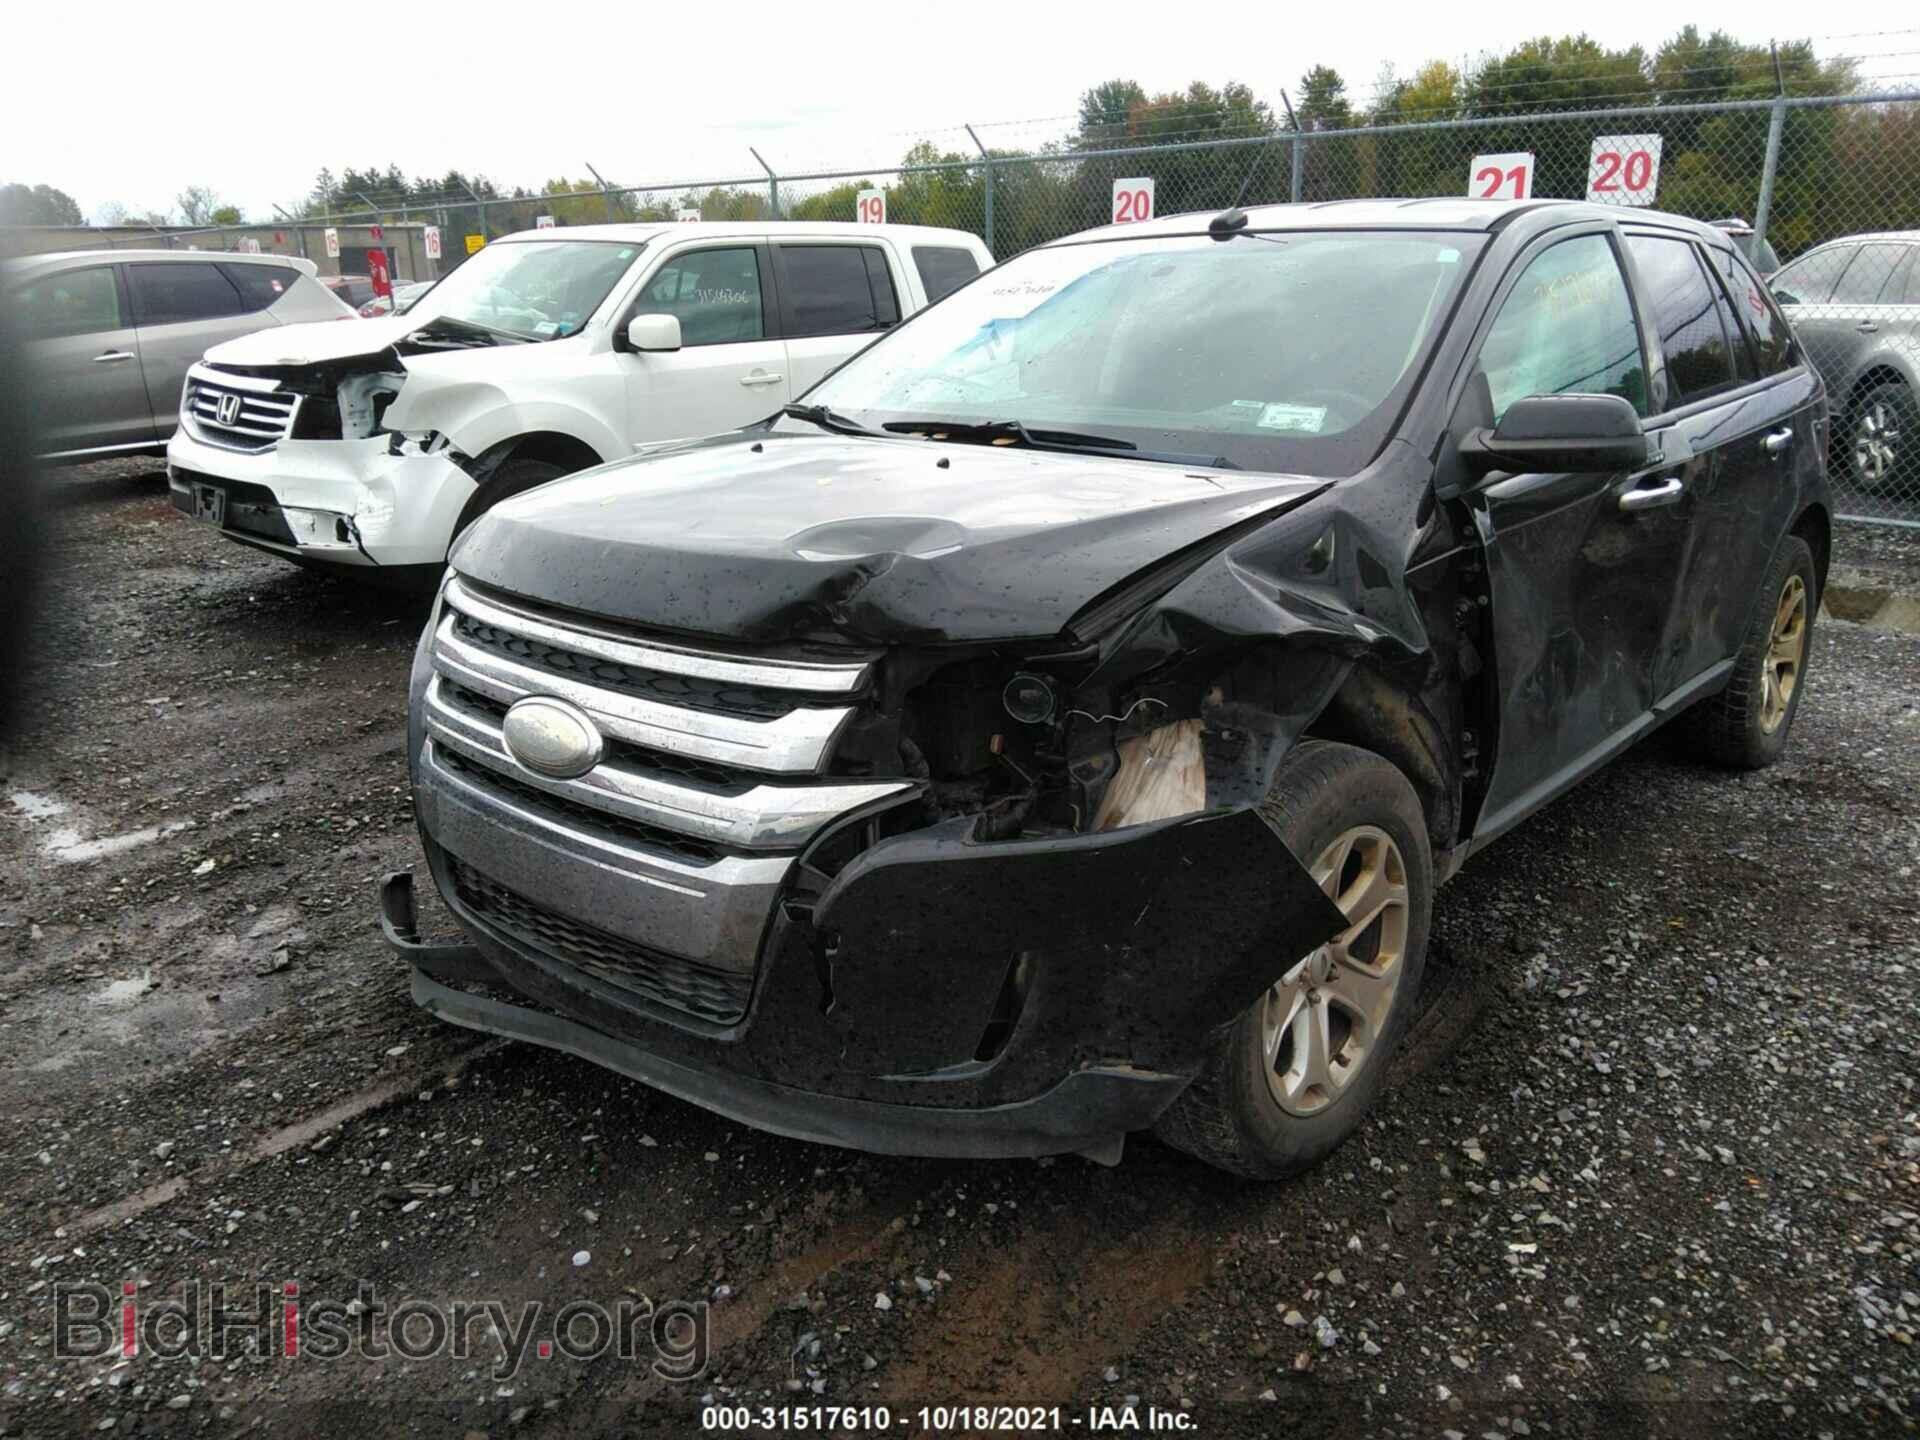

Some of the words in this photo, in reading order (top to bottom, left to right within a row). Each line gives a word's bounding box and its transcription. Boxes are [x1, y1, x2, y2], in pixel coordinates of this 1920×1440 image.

[1476, 165, 1527, 199] 21
[1592, 150, 1652, 192] 20
[858, 196, 884, 224] 19
[1115, 190, 1150, 222] 20
[426, 231, 439, 253] 16
